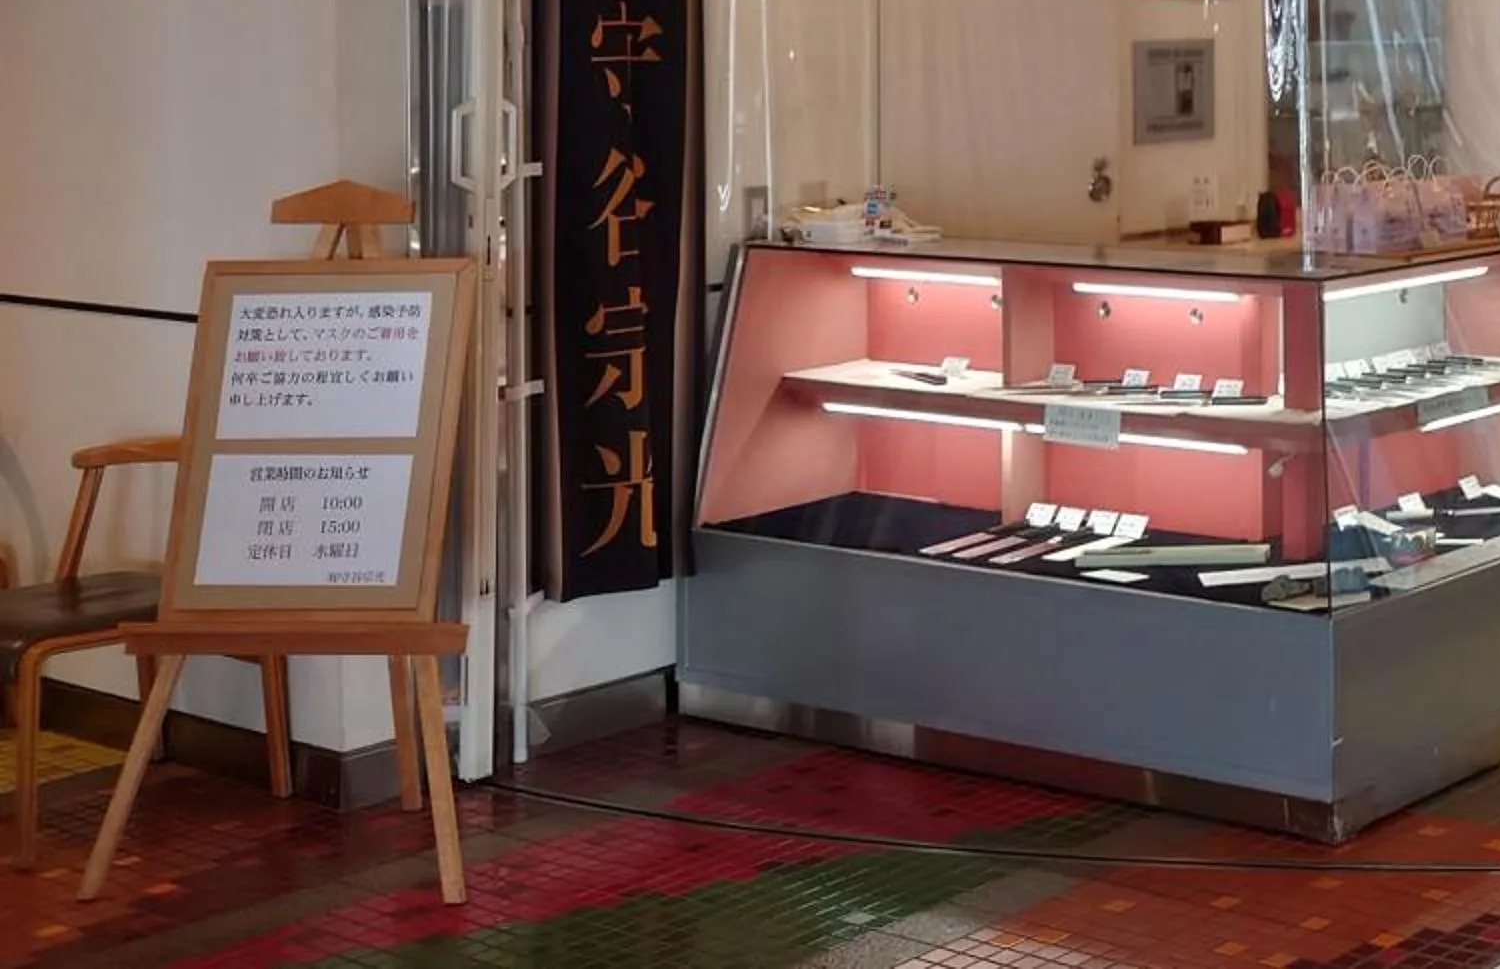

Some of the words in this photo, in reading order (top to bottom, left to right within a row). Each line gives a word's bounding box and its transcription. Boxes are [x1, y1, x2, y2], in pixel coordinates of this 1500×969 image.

[250, 466, 370, 481] 営業時間のお知らせ
[321, 496, 363, 511] 10:00
[320, 520, 361, 534] 15:00
[248, 544, 292, 560] 定休日
